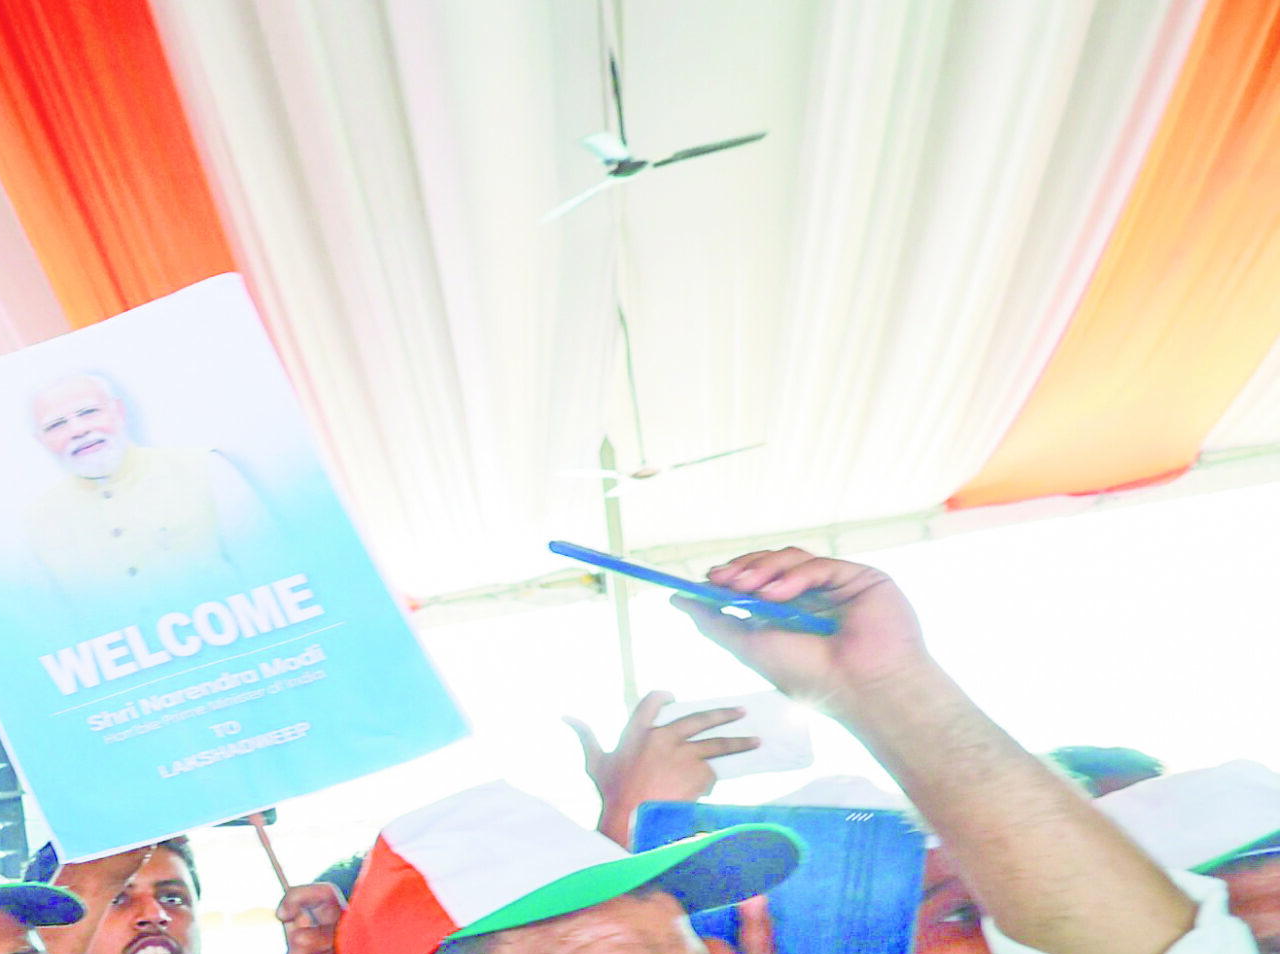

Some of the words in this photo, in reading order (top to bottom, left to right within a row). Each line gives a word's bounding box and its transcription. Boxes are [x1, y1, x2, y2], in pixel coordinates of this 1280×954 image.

[37, 573, 326, 696] WELCOME
[86, 700, 140, 732] Shri
[139, 669, 260, 716] Narendra
[258, 643, 328, 678] Modi
[156, 722, 312, 779] LAKSHADWEEP
[208, 719, 243, 739] TO
